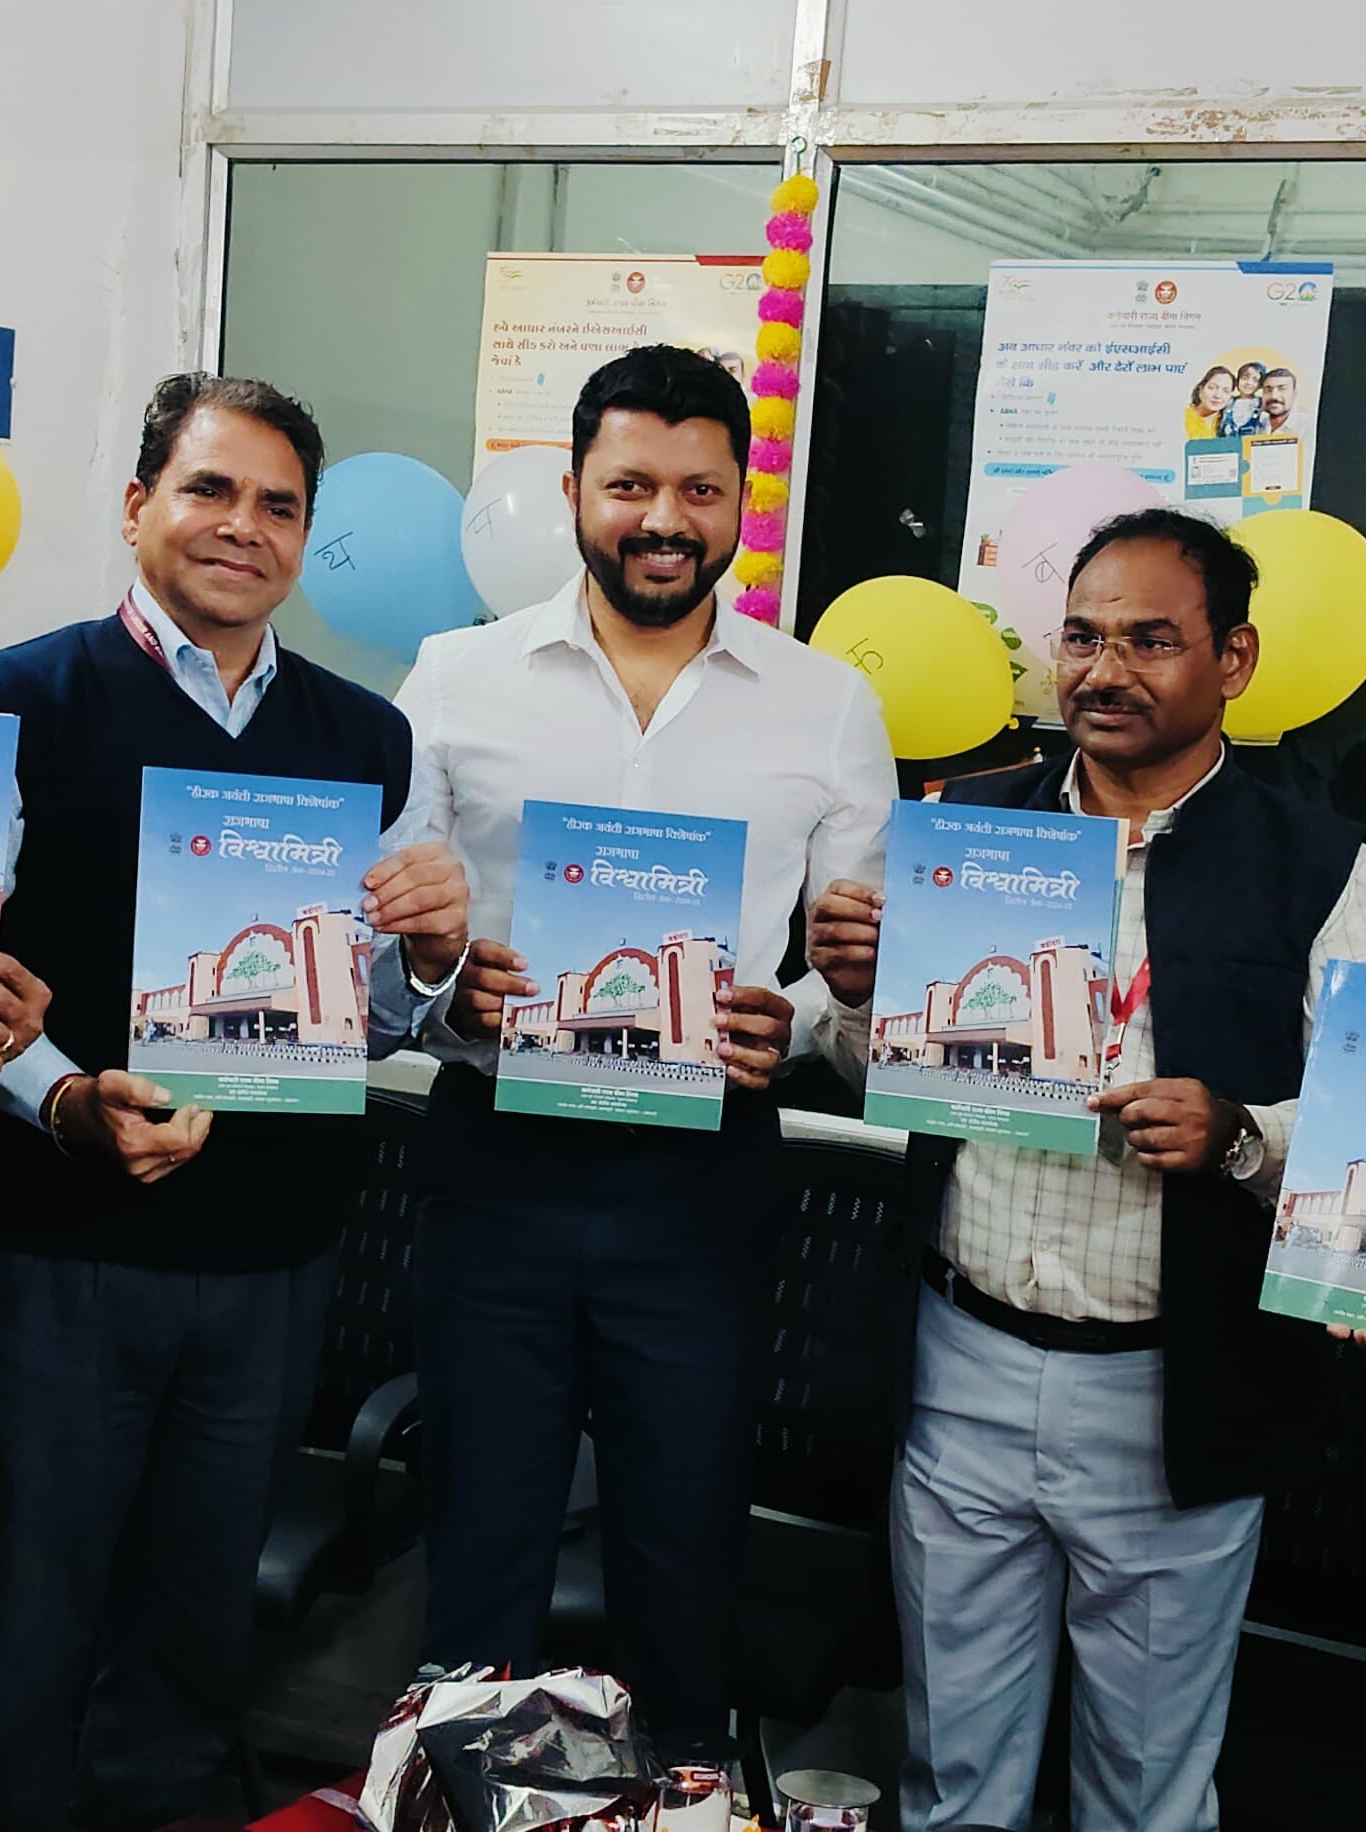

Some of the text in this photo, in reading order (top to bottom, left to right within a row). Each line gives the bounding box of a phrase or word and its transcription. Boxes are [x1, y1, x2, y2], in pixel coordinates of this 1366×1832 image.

[218, 830, 343, 867] विश्वामित्री
[590, 859, 709, 896] विश्वामित्री
[960, 861, 1080, 900] विश्वामित्री
